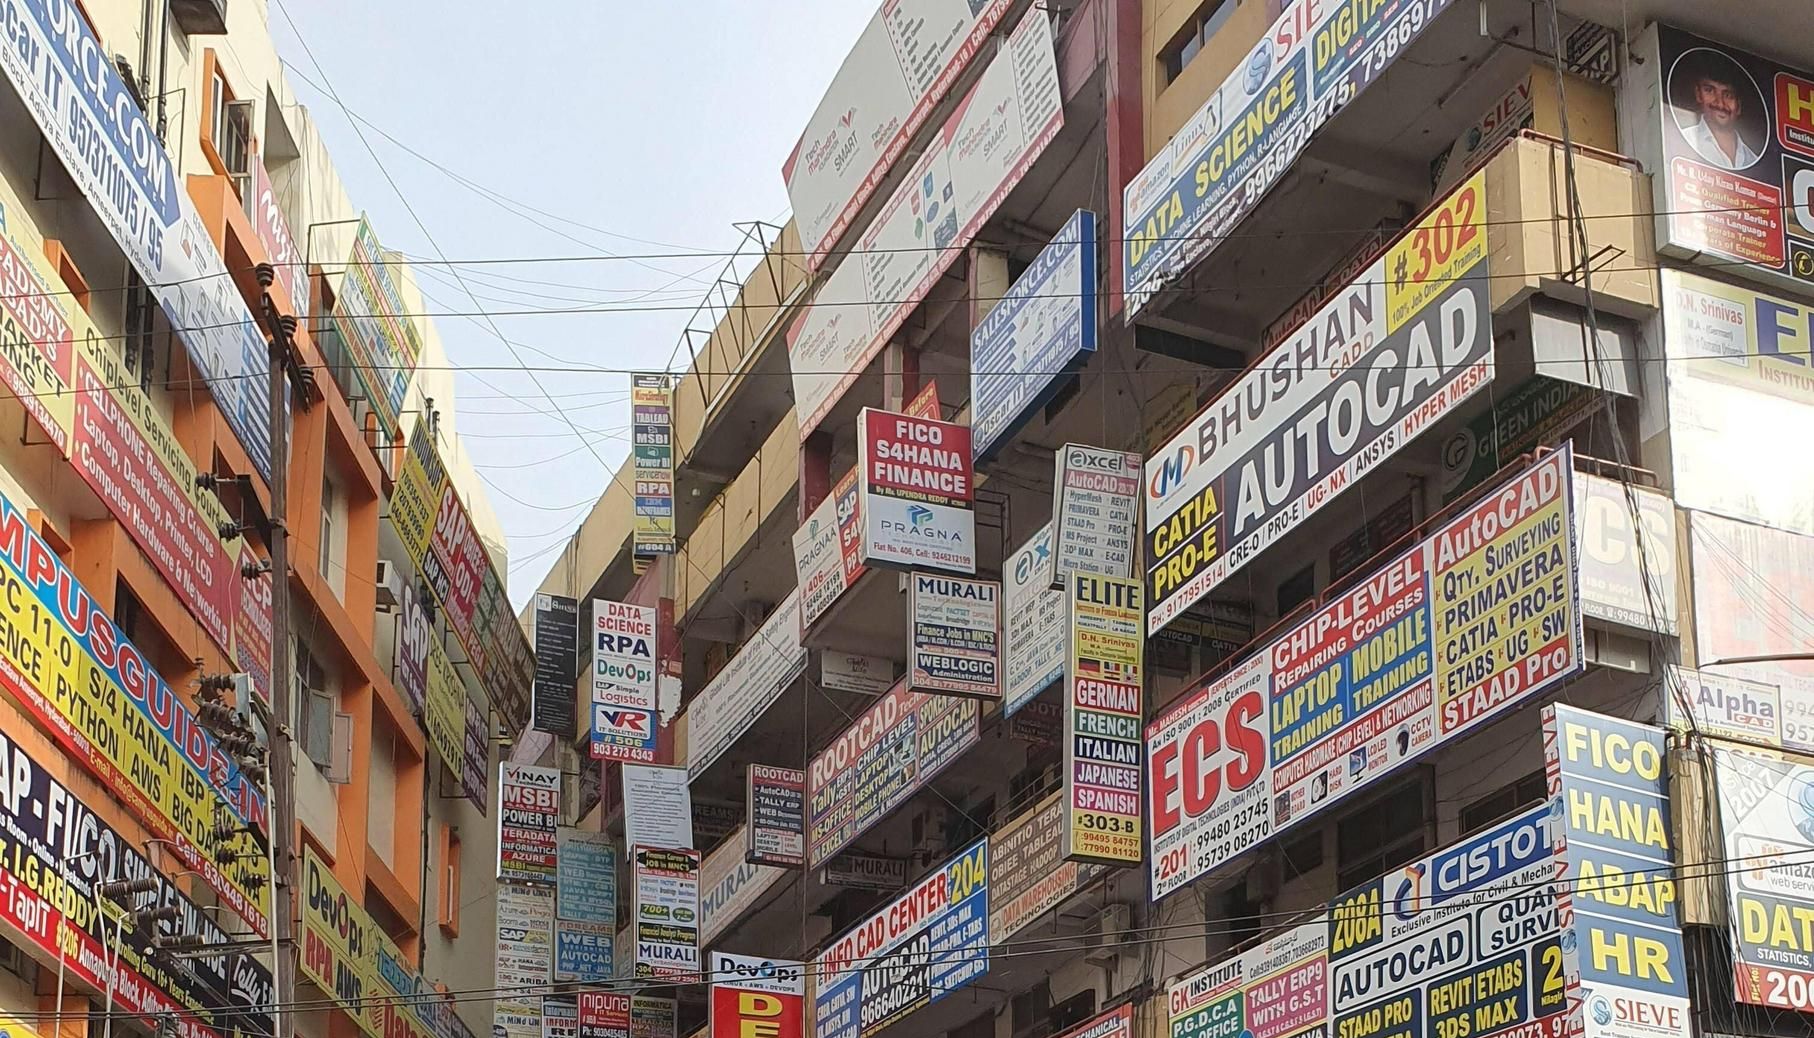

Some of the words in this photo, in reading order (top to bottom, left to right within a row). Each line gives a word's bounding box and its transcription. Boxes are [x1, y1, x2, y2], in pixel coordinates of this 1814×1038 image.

[1130, 191, 1184, 267] DATA
[1195, 68, 1296, 197] SCIENCE
[1412, 188, 1477, 283] 302
[1199, 278, 1374, 466] BHUSHAN
[1329, 331, 1374, 379] CADD
[86, 328, 141, 420] Chiplevel
[144, 410, 191, 493] Servicing
[1233, 287, 1477, 536] AUTOCAD
[1404, 395, 1447, 437] HYPER
[1450, 360, 1486, 404] MESH
[877, 439, 963, 472] S4HANA
[896, 421, 942, 444] FICO
[82, 408, 121, 479] Laptop,
[124, 464, 162, 526] Desktop,
[875, 464, 966, 494] FINANCE
[81, 444, 131, 516] Computer
[133, 507, 173, 572] Hardware
[882, 521, 962, 541] PRAGNA
[1153, 486, 1218, 558] CATIA
[1437, 462, 1557, 571] AutoCAD
[1153, 527, 1217, 601] PRO-E
[608, 604, 641, 619] DATA
[1076, 577, 1139, 610] ELITE
[1444, 545, 1563, 634] PRIMAVERA
[598, 616, 651, 635] SCIENCE
[1274, 561, 1421, 670] CHIP-LEVEL
[598, 634, 650, 657] RPA
[919, 654, 993, 676] WEBLOGIC
[1352, 608, 1426, 683] MOBILE
[597, 660, 651, 682] DevOps
[1076, 679, 1139, 710] GERMAN
[600, 690, 647, 706] Logistics
[1272, 662, 1342, 734] LAPTOP
[56, 674, 118, 758] PYTHON
[131, 757, 161, 802] AWS
[1078, 713, 1137, 735] FRENCH
[1411, 729, 1432, 749] CAMERA
[593, 745, 611, 756] 903
[612, 746, 628, 758] 273
[629, 748, 652, 761] 4343
[1078, 739, 1136, 762] ITALIAN
[1152, 691, 1266, 838] ECS
[1566, 722, 1661, 782] FICO
[503, 787, 558, 807] MSBI
[1077, 763, 1137, 788] JAPANESE
[1077, 789, 1138, 813] SPANISH
[1082, 815, 1134, 834] 303-B
[1569, 789, 1669, 850] HANA
[503, 829, 556, 842] TERADATA
[1233, 821, 1269, 850] 08270
[951, 848, 985, 903] 204
[1160, 842, 1188, 880] 201
[308, 863, 363, 959] DevOps
[1576, 860, 1675, 917] ABAP
[824, 942, 853, 982] INFO
[857, 921, 886, 959] CAD
[888, 874, 947, 938] CENTER
[305, 927, 334, 989] RPA
[336, 959, 362, 1017] AWS
[639, 945, 697, 962] MURALI
[1337, 933, 1464, 1003] AUTOCAD
[1590, 928, 1674, 984] HR
[1431, 983, 1470, 1016] REVIT
[1476, 967, 1523, 1004] ETABS
[1615, 997, 1682, 1031] SIEVE
